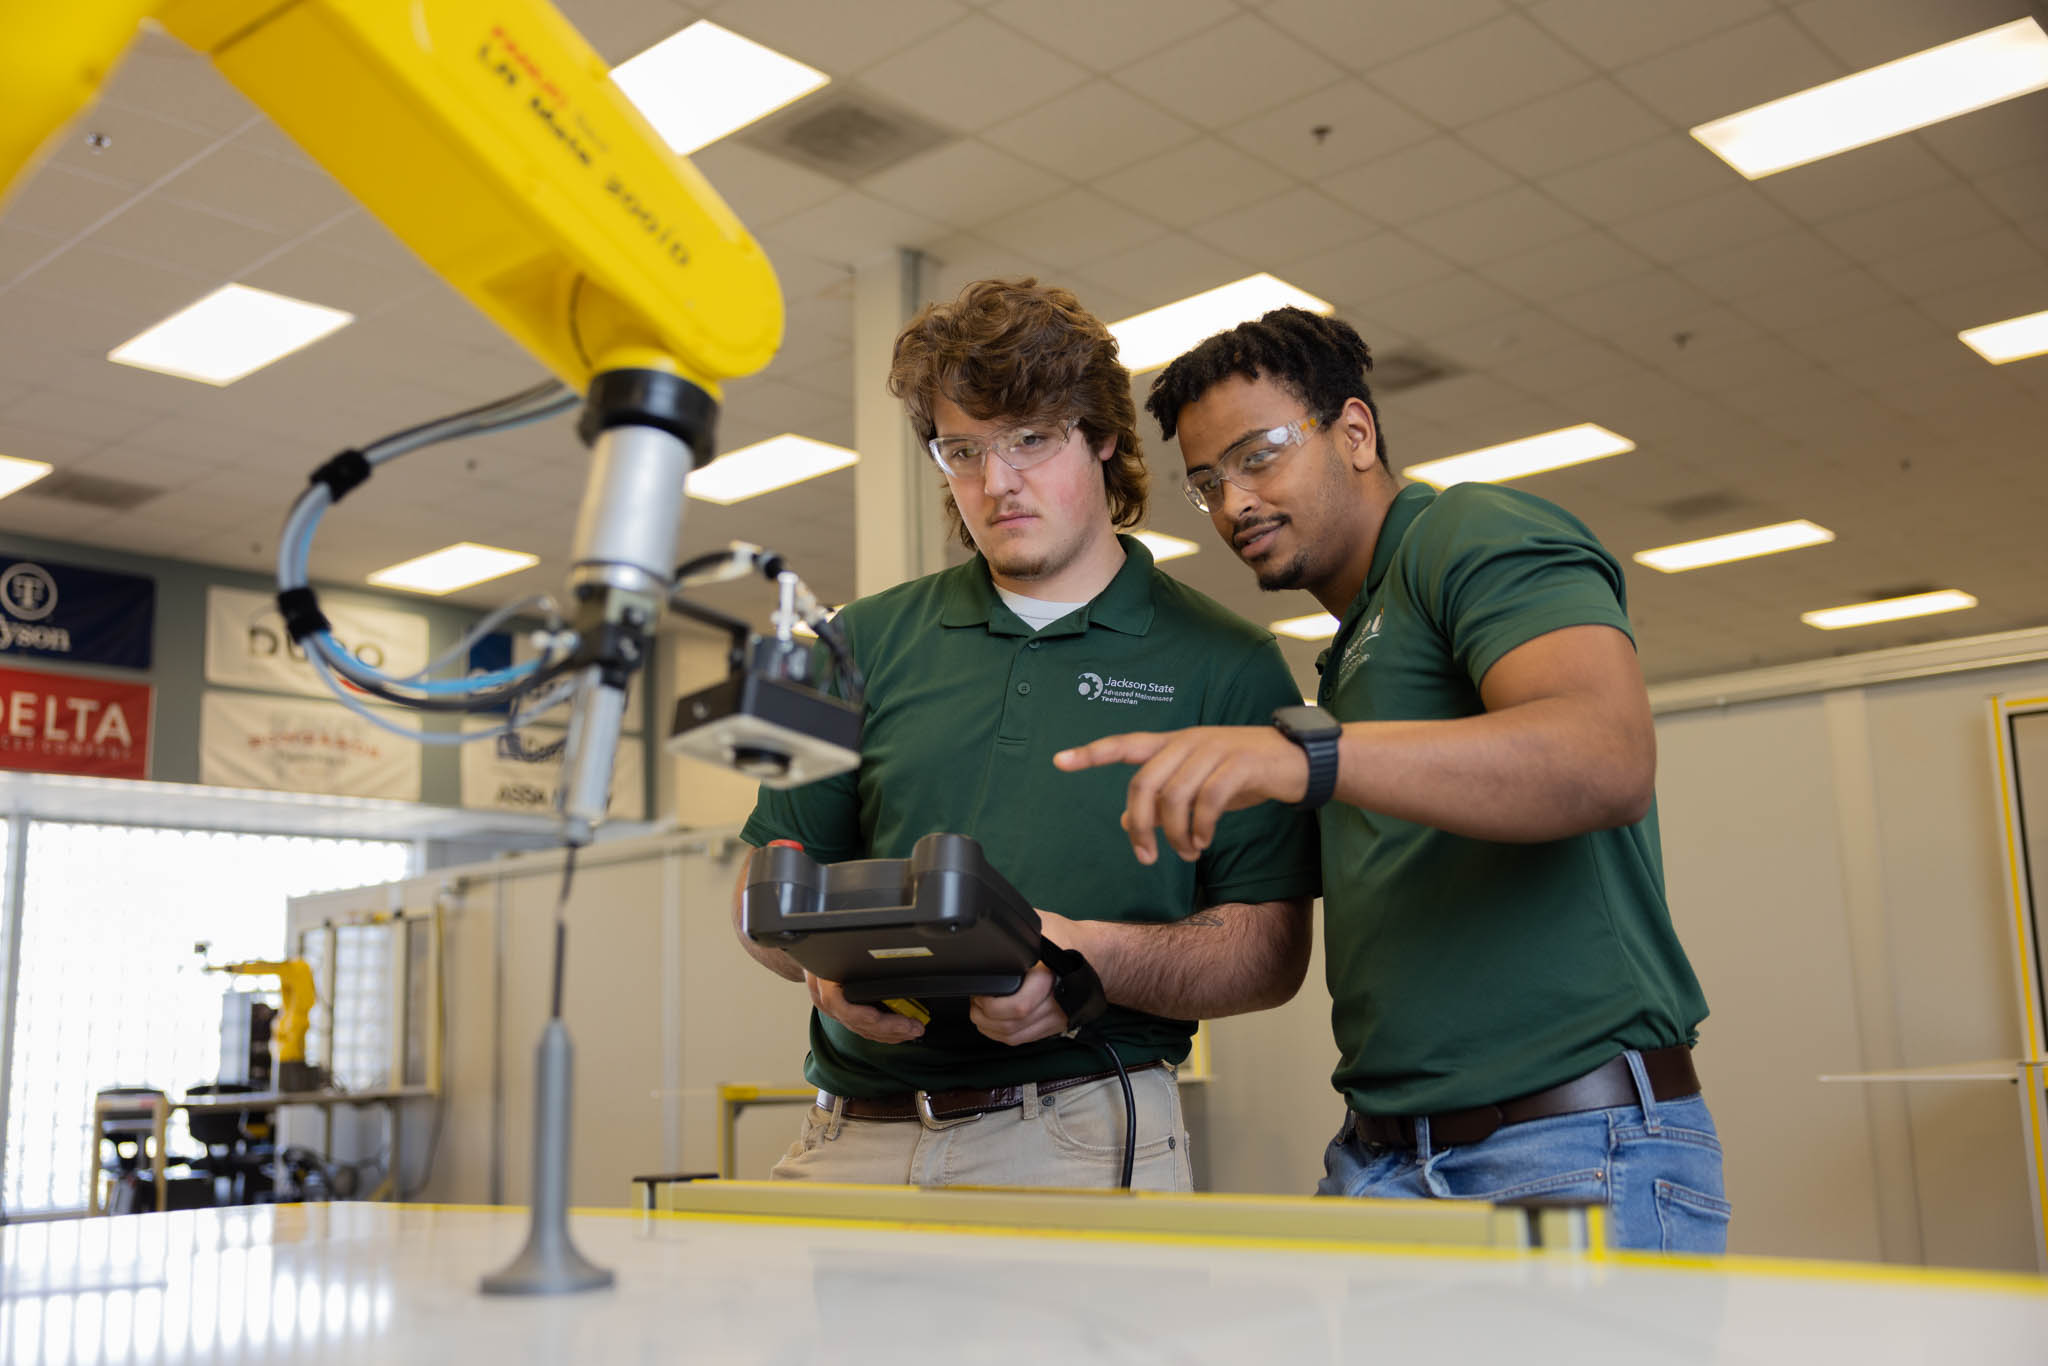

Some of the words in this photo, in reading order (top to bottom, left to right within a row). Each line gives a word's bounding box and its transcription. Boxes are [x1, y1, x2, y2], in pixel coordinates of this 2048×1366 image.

[0, 613, 71, 653] yson
[249, 626, 384, 669] DUO
[1103, 689, 1134, 697] Advanced
[1105, 677, 1147, 690] Jackson
[1148, 683, 1175, 693] State
[1101, 695, 1138, 705] Technician
[0, 690, 132, 749] ELTA
